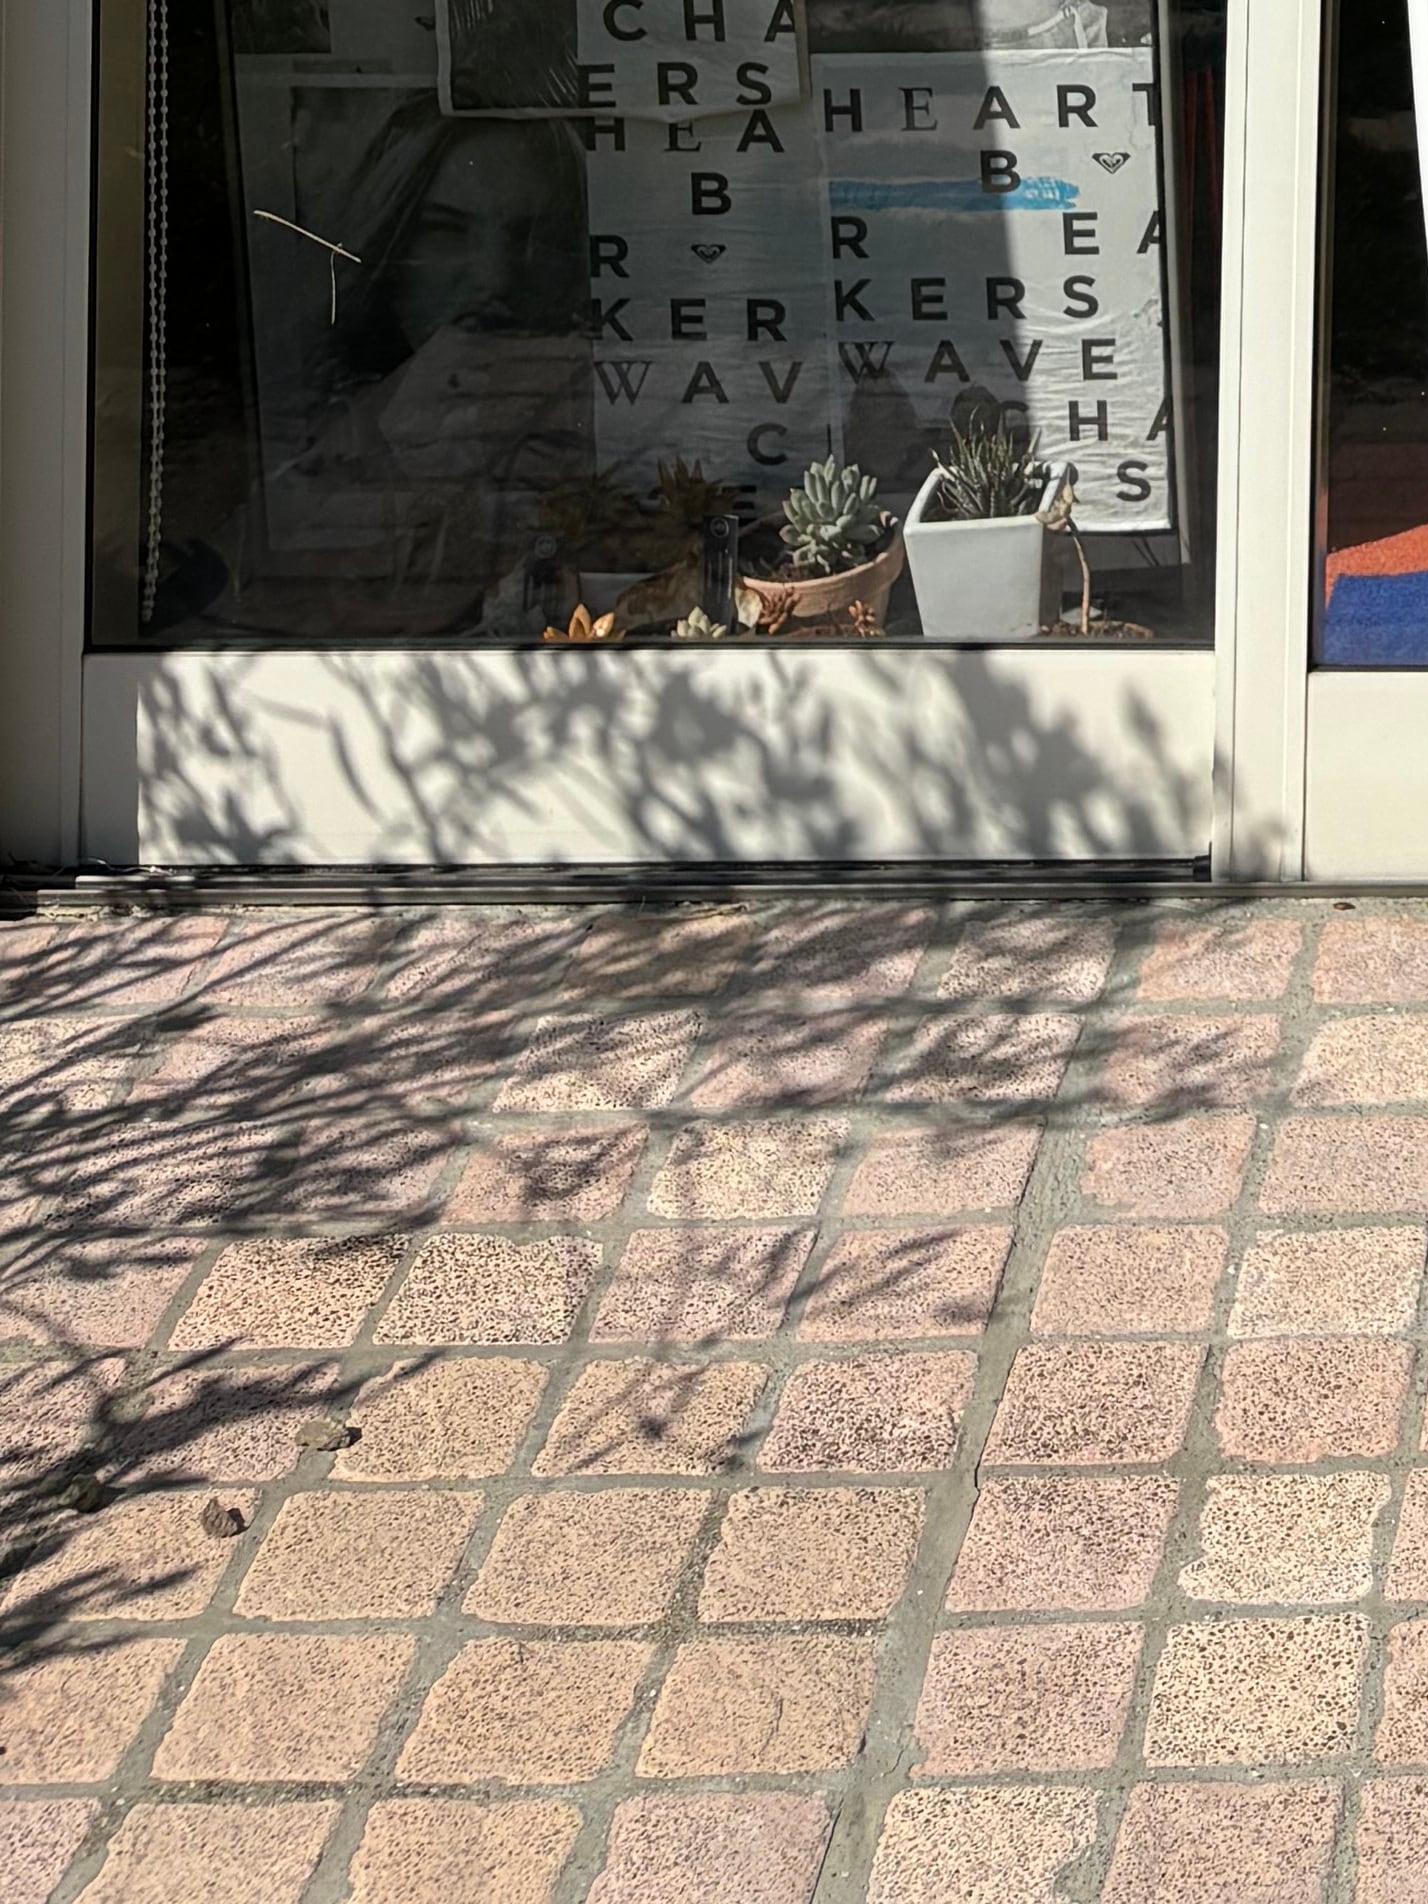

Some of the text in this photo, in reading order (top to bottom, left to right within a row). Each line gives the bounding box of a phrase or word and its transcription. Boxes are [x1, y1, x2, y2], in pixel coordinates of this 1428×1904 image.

[823, 83, 1157, 132] HEART
[691, 171, 732, 216] B
[981, 150, 1021, 193] B
[835, 276, 1099, 322] KERS
[838, 339, 1118, 383] WAVE
